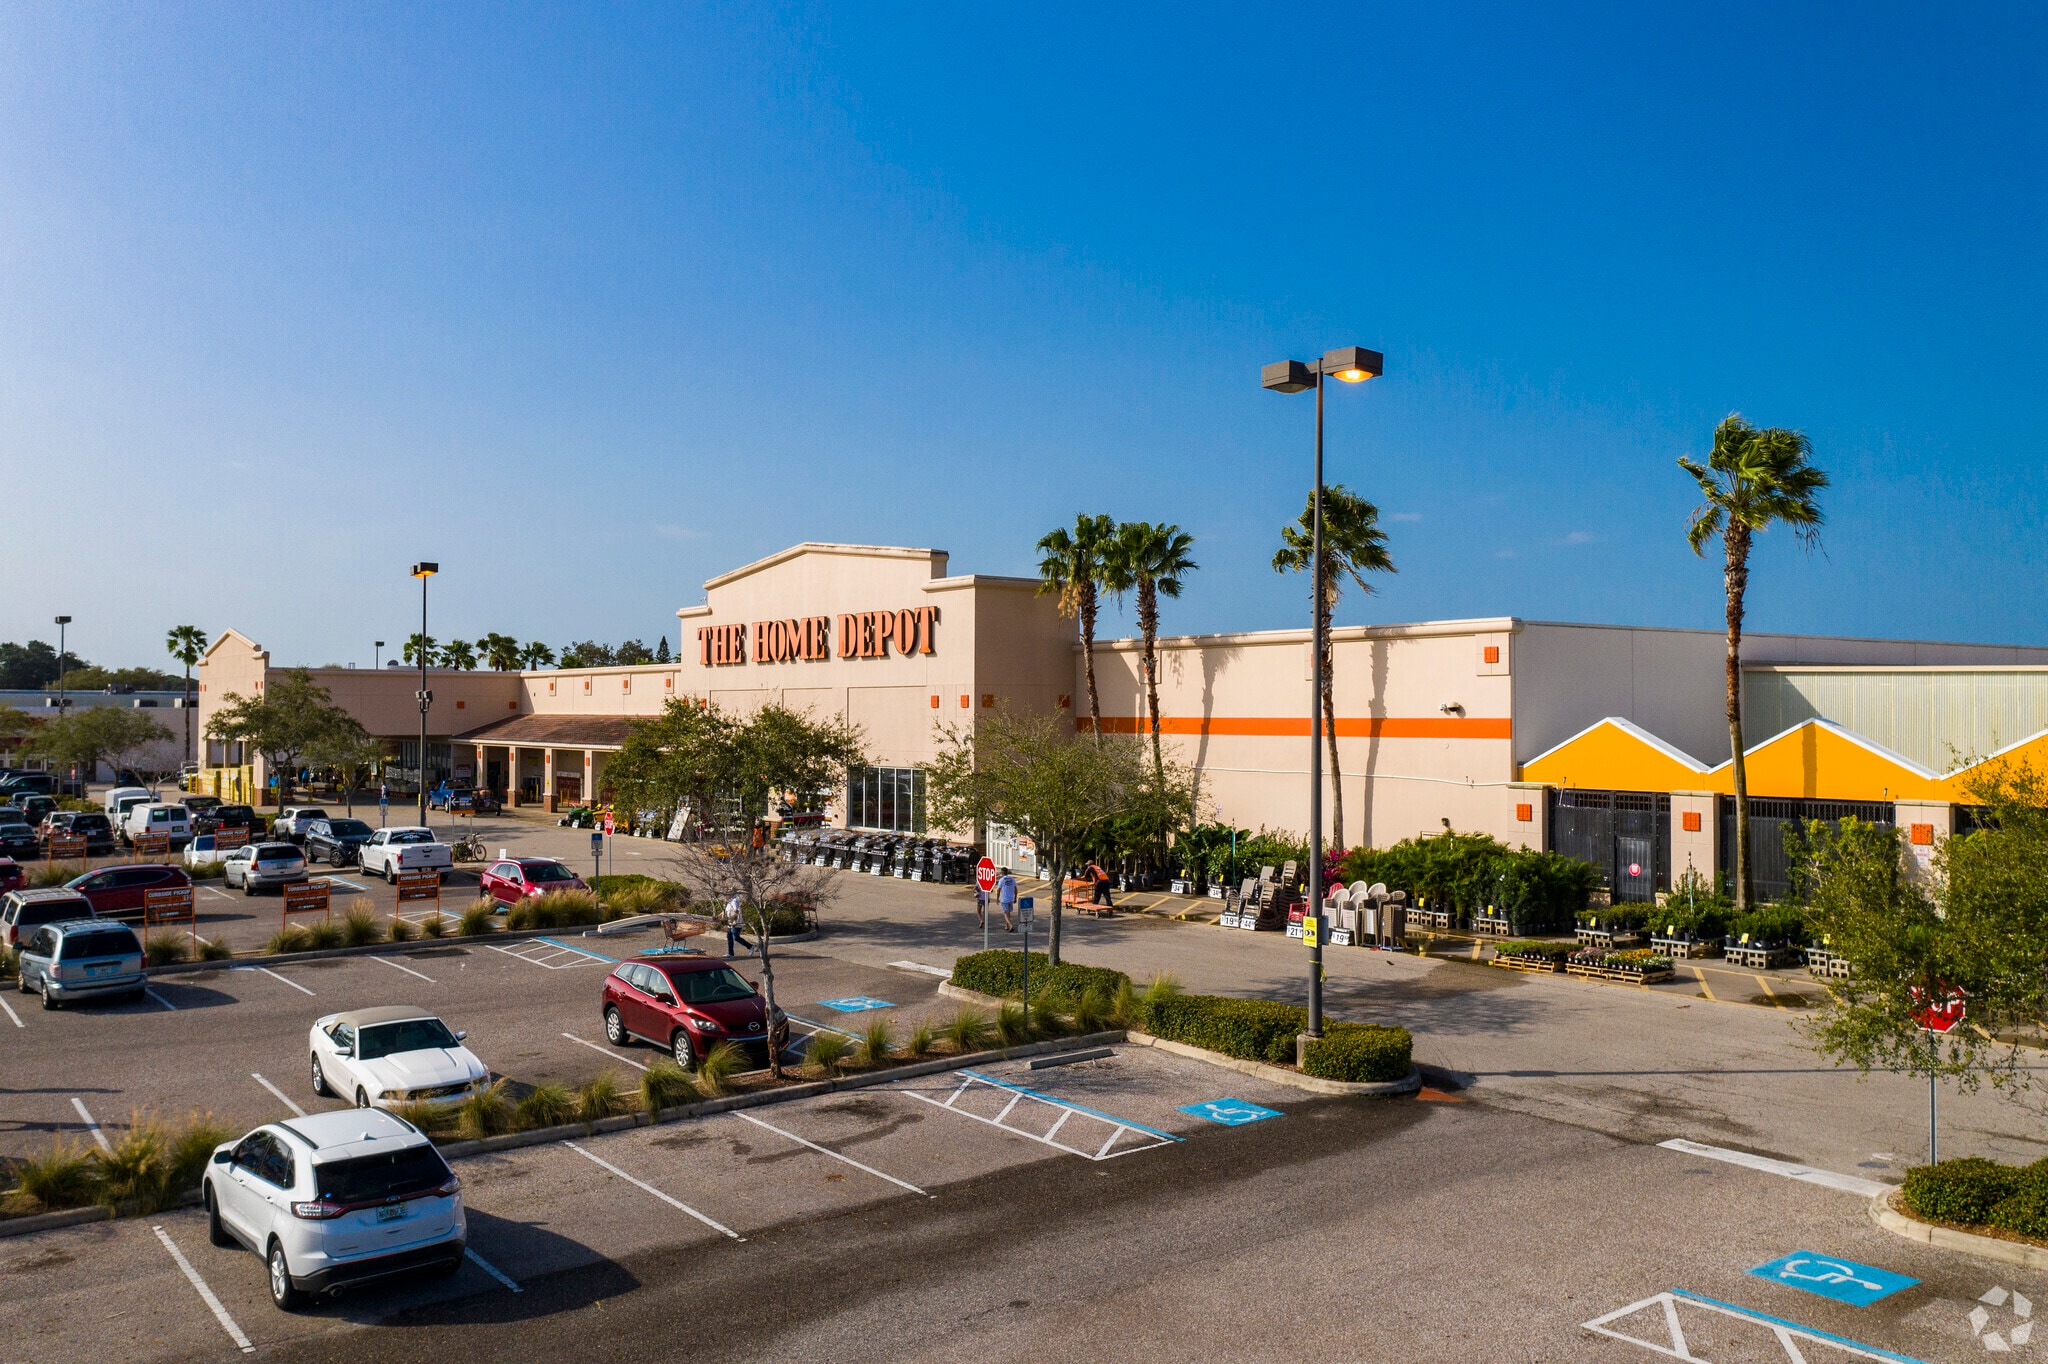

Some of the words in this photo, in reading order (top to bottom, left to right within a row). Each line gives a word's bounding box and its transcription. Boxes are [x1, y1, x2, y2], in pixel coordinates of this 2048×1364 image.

[697, 623, 746, 665] THE
[751, 616, 829, 662] HOME
[837, 606, 939, 658] DEPOT
[978, 867, 995, 881] STOP
